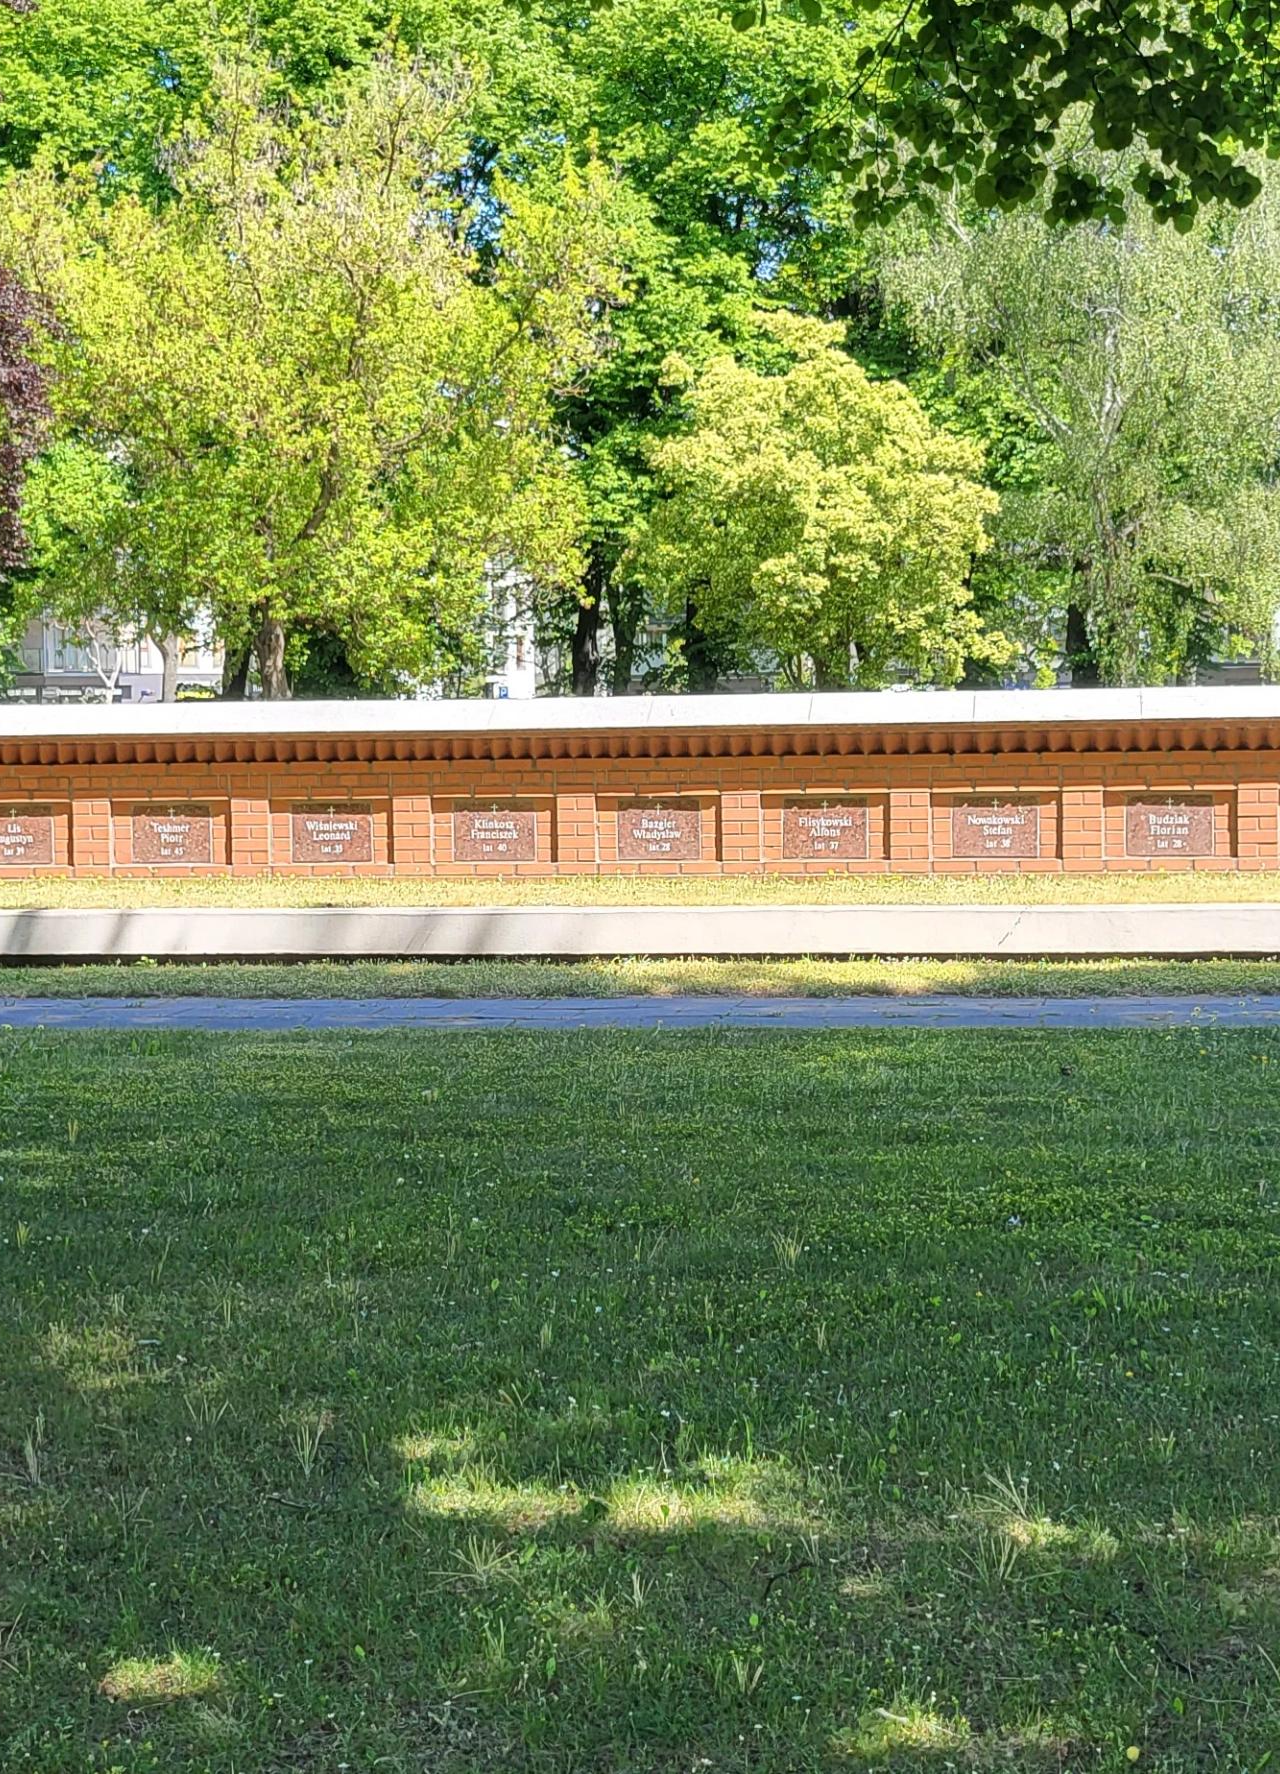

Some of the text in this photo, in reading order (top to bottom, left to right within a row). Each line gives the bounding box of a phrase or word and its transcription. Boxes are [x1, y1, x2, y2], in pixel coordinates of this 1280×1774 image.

[799, 816, 853, 827] Flisykowski
[967, 815, 1025, 825] Nowakowski
[1149, 814, 1189, 824] Budziak
[8, 823, 21, 833] Lis
[809, 827, 841, 837] Alfons
[983, 825, 1012, 835] Stefan
[1150, 825, 1189, 835] Florian
[160, 833, 183, 843] Piotr
[313, 831, 351, 841] Leonard
[471, 829, 518, 839] Franciszek
[830, 841, 839, 850] 37
